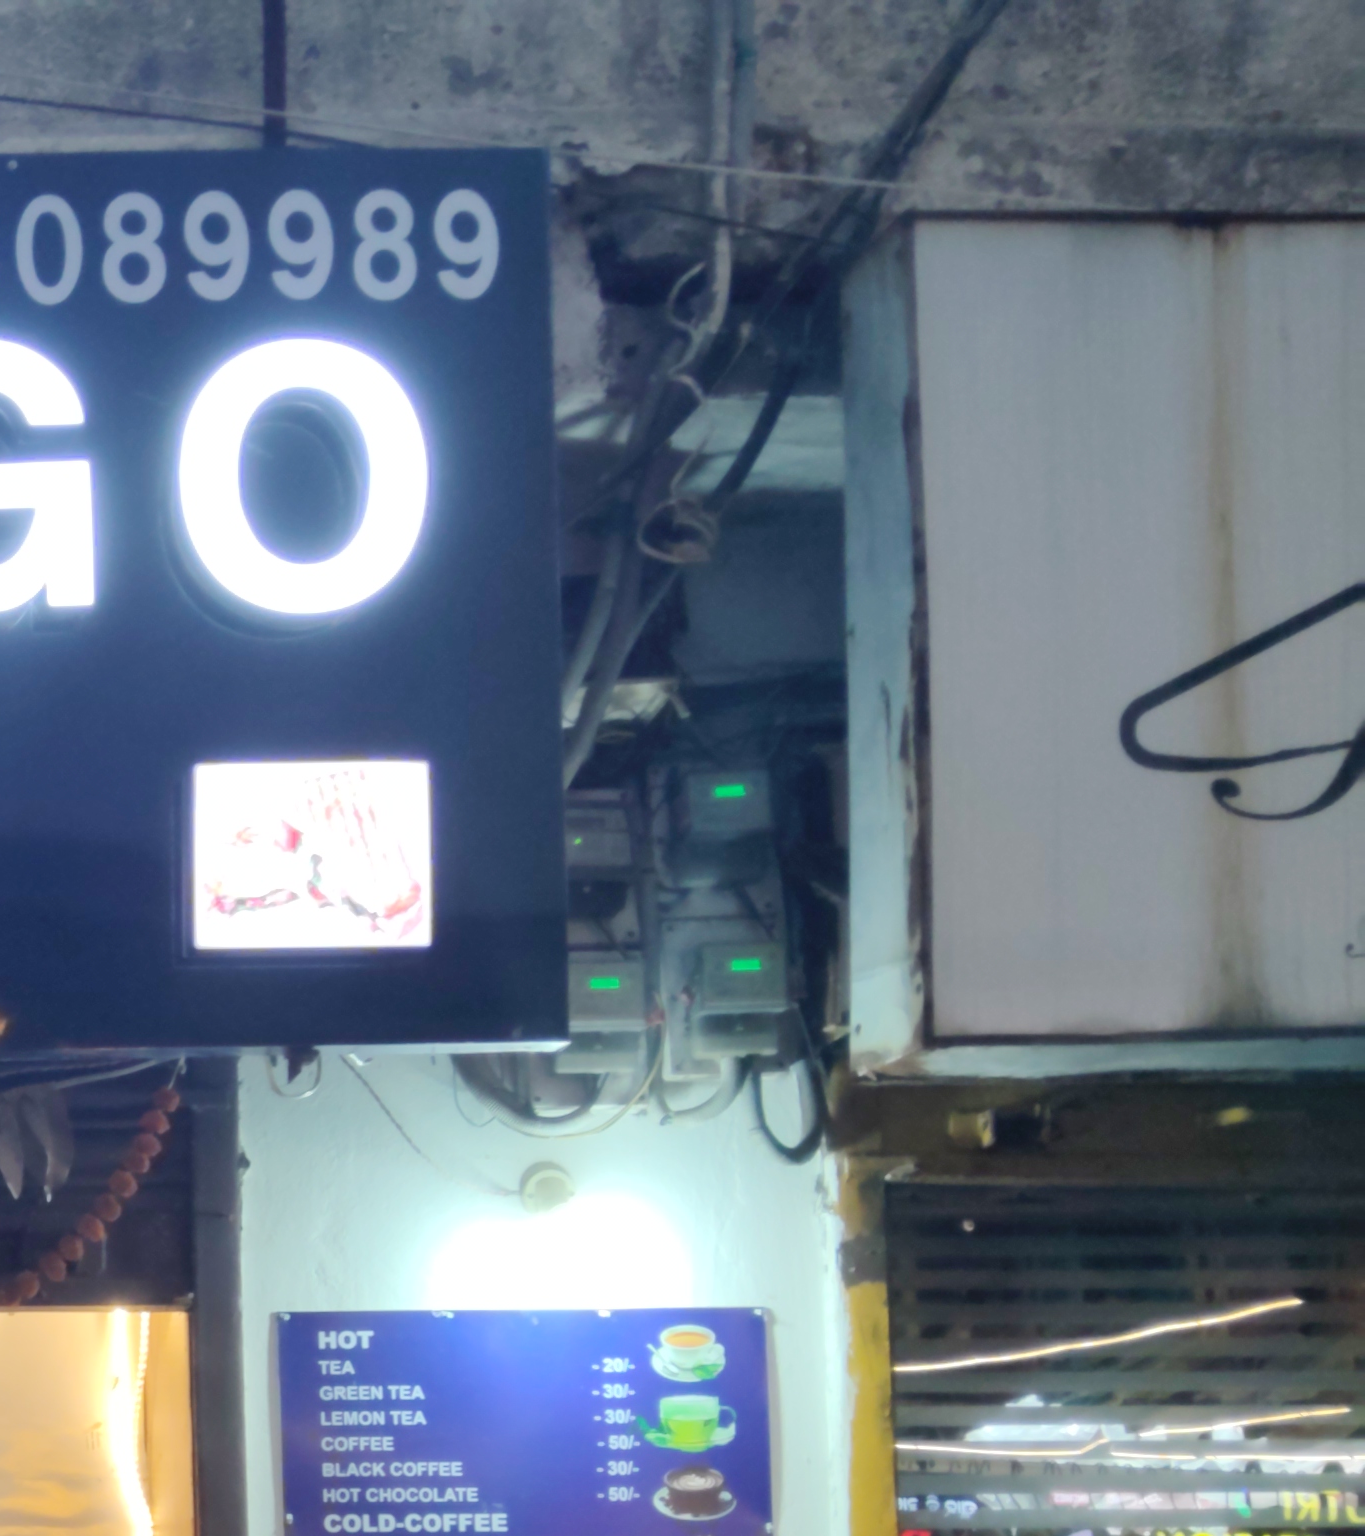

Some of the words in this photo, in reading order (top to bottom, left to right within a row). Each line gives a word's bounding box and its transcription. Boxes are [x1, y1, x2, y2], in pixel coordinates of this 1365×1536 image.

[318, 1331, 374, 1349] HOT
[319, 1361, 355, 1375] TEA
[319, 1386, 384, 1400] GREEN
[388, 1386, 425, 1400] TEA
[321, 1411, 386, 1425] LEMON
[390, 1411, 427, 1425] TEA
[321, 1437, 394, 1451] COFFEE
[322, 1463, 386, 1477] BLACK
[390, 1462, 463, 1476] COFFEE
[323, 1488, 360, 1502] HOT
[365, 1488, 479, 1502] CHOCOLATE
[324, 1514, 508, 1532] COLD-COFFEE
